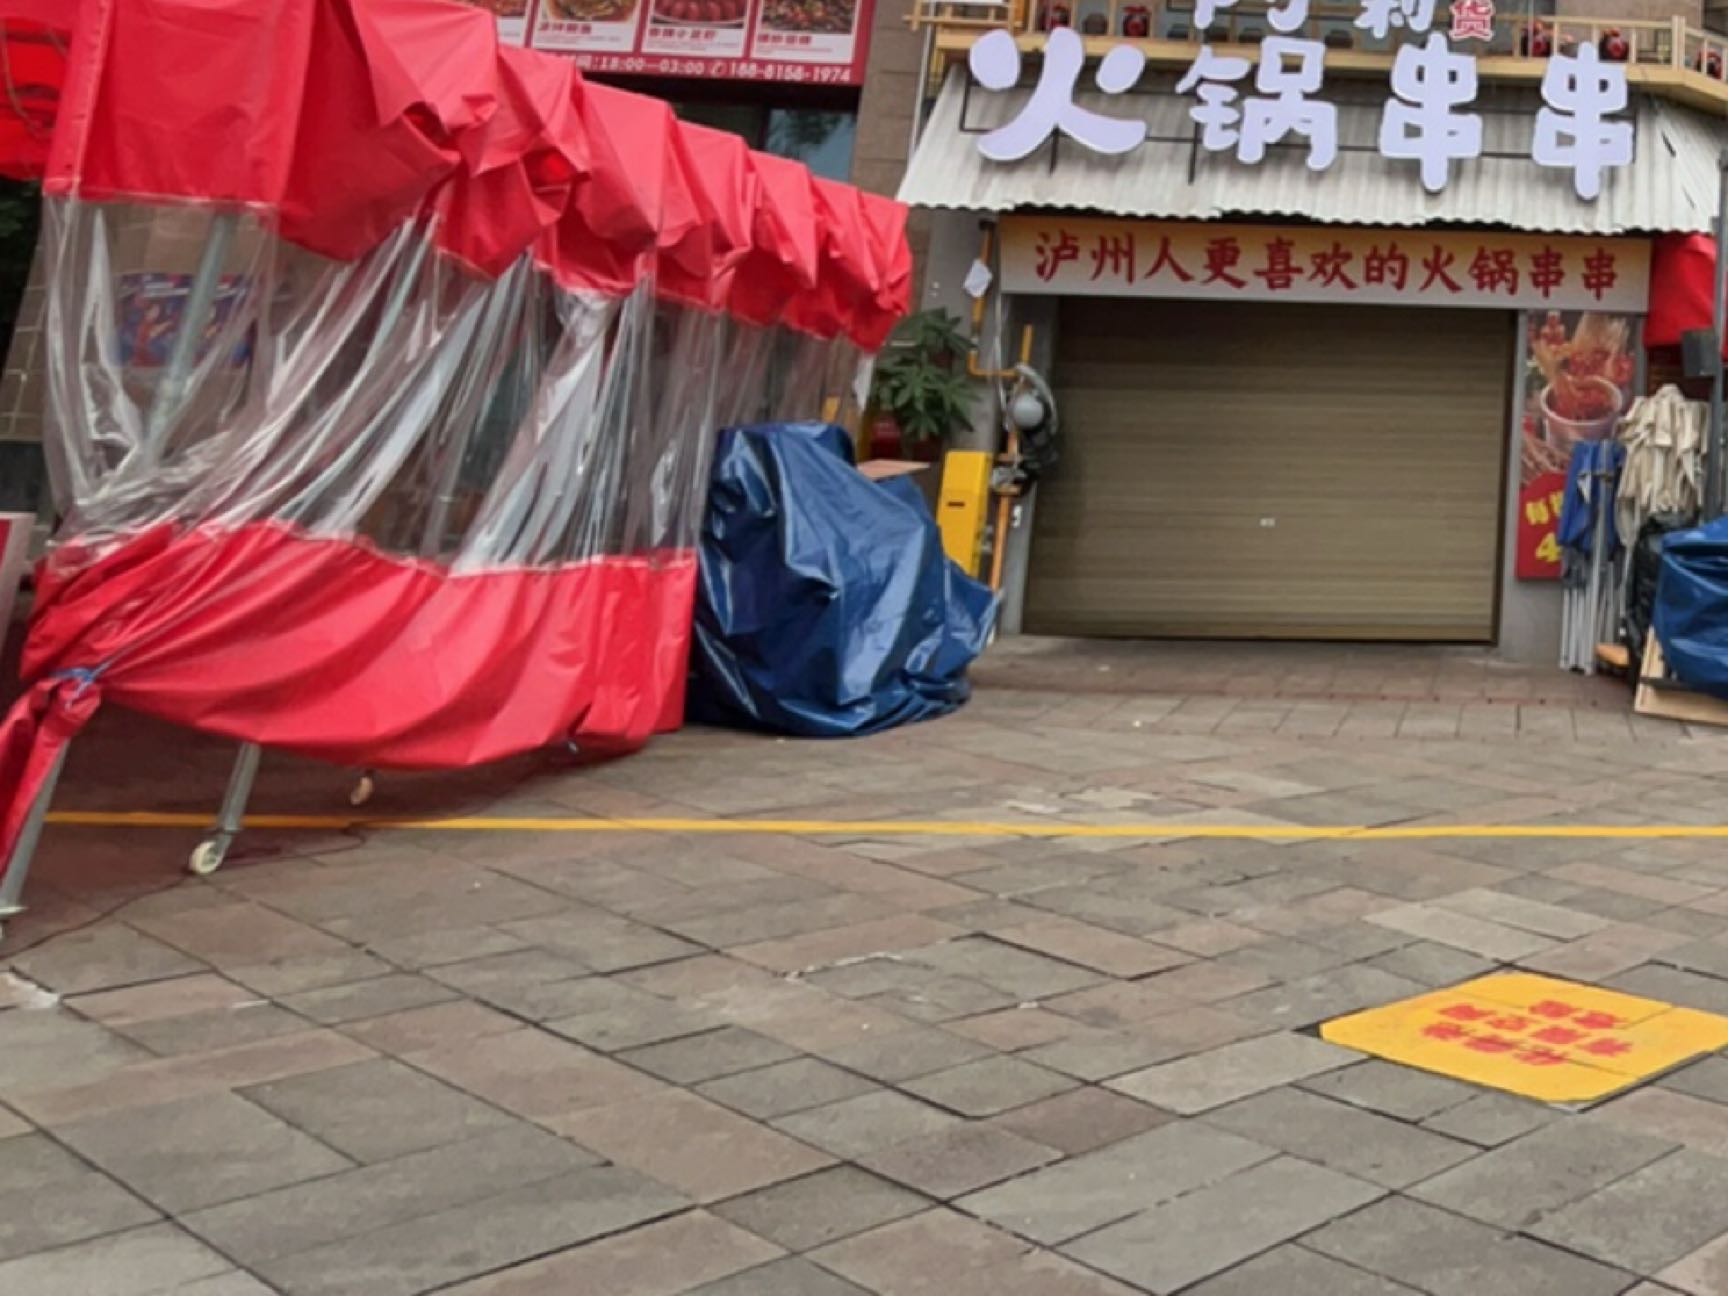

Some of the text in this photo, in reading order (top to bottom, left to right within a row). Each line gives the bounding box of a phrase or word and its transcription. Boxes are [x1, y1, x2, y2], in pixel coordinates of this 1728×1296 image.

[968, 26, 1634, 201] 火锅串串
[1034, 230, 1620, 301] 泸州人更喜欢的火锅串串
